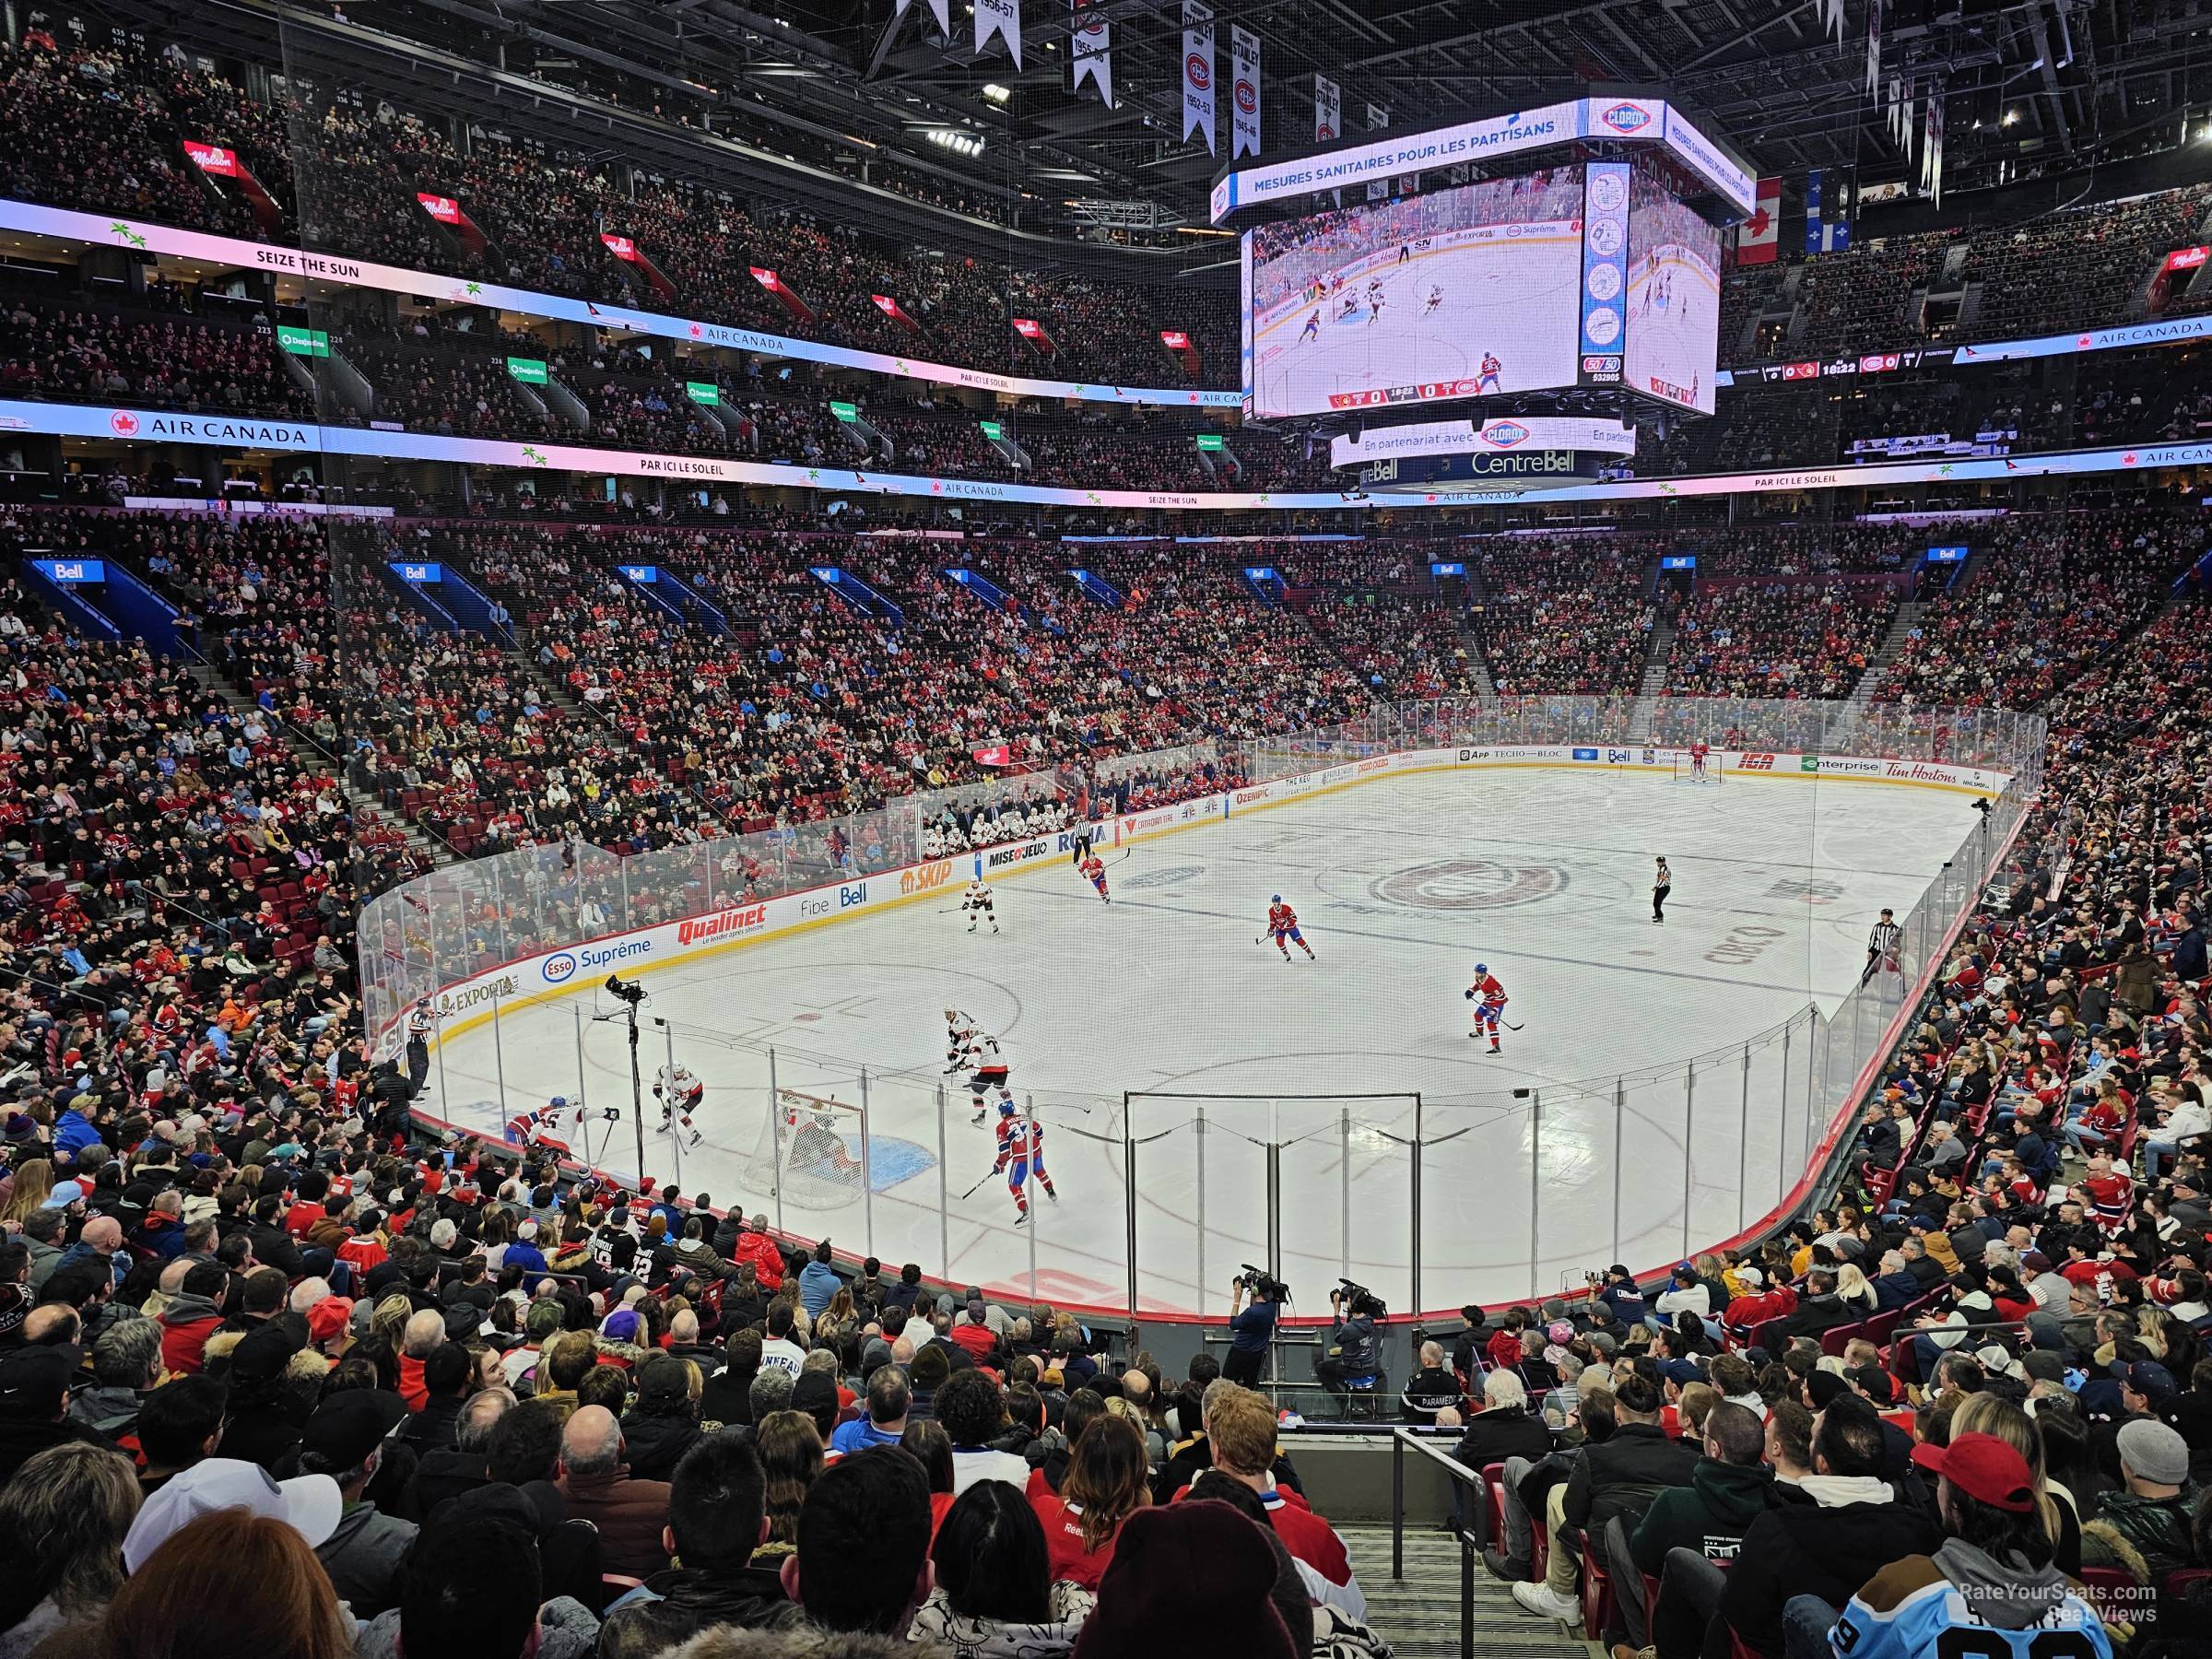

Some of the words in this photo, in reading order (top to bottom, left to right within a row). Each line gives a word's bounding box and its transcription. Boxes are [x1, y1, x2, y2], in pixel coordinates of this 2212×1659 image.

[1194, 37, 1204, 47] CUP
[1233, 41, 1259, 67] STANLEY
[1186, 93, 1211, 115] 1952-53
[1607, 111, 1646, 125] CLOROX
[190, 149, 232, 170] Molson
[1254, 172, 1312, 192] MESURES
[1316, 155, 1394, 181] SANITAIRES
[1397, 147, 1437, 164] POUR
[1440, 140, 1465, 155] LES
[1470, 121, 1555, 147] PARTISANS
[1672, 124, 1691, 151] MESURES
[1692, 142, 1714, 170] SANITAIRES
[1714, 162, 1725, 179] POUR
[1731, 177, 1750, 201] PARTISANS
[423, 200, 455, 216] Molson
[1524, 225, 1557, 235] Suprême
[1414, 238, 1431, 251] SN
[257, 250, 295, 267] SEIZE
[300, 257, 325, 273] THE
[330, 263, 359, 278] SUN
[2172, 253, 2206, 266] Molson
[257, 325, 272, 335] 223
[2099, 333, 2128, 345] AIR
[2132, 323, 2204, 340] CANADA
[291, 336, 324, 349] Desjardins
[707, 328, 729, 342] AIR
[733, 332, 783, 350] CANADA
[518, 366, 545, 377] Desjardins
[1586, 359, 1618, 371] 50/50
[1785, 367, 1795, 377] 0
[1885, 357, 1896, 367] 0
[960, 372, 972, 382] PAR
[973, 374, 982, 383] ICI
[982, 375, 989, 384] LE
[990, 376, 1008, 388] SOLEIL
[1371, 390, 1381, 404] 0
[1426, 384, 1435, 397] 0
[1203, 394, 1220, 403] AIR
[151, 418, 194, 436] AIR
[203, 422, 307, 444] CANADA
[1487, 429, 1524, 441] CLOROX
[1593, 429, 1604, 441] En
[1365, 440, 1376, 451] En
[1378, 434, 1441, 451] partenariat
[1444, 432, 1474, 444] avec
[1472, 450, 1574, 475] CentreBell
[2146, 452, 2175, 463] AIR
[641, 458, 661, 471] PAR
[664, 460, 677, 471] ICI
[679, 461, 689, 473] LE
[691, 462, 724, 476] SOLEIL
[1755, 478, 1773, 487] PAR
[1791, 477, 1802, 485] LE
[1804, 475, 1837, 485] SOLEIL
[945, 483, 962, 494] AIR
[964, 484, 1004, 497] CANADA
[1443, 492, 1464, 501] AIR
[1467, 491, 1521, 500] CANADA
[1148, 495, 1167, 504] SEIZE
[1169, 495, 1180, 505] THE
[1181, 496, 1197, 505] SUN
[1939, 548, 1955, 559] Bell
[1441, 566, 1453, 574] Bell
[1671, 557, 1688, 569] Bell
[55, 563, 83, 580] Bell
[405, 566, 426, 580] Bell
[629, 569, 645, 581] Bell
[1253, 570, 1265, 578] Bell
[1608, 749, 1630, 762] Bell
[1738, 753, 1775, 771] IGA
[1372, 759, 1389, 771] pizza
[1805, 759, 1878, 771] enterprise
[1887, 762, 1909, 777] Tim
[1911, 764, 1957, 783] Hortons
[1286, 778, 1297, 787] THE
[1299, 774, 1311, 784] KEG
[1137, 816, 1162, 830] CANADIAN
[915, 860, 952, 891] SKIP
[841, 882, 867, 908] Bell
[800, 899, 830, 917] Fibe
[677, 904, 767, 947] Qualinet
[547, 960, 571, 975] Esso
[581, 940, 651, 969] Suprême
